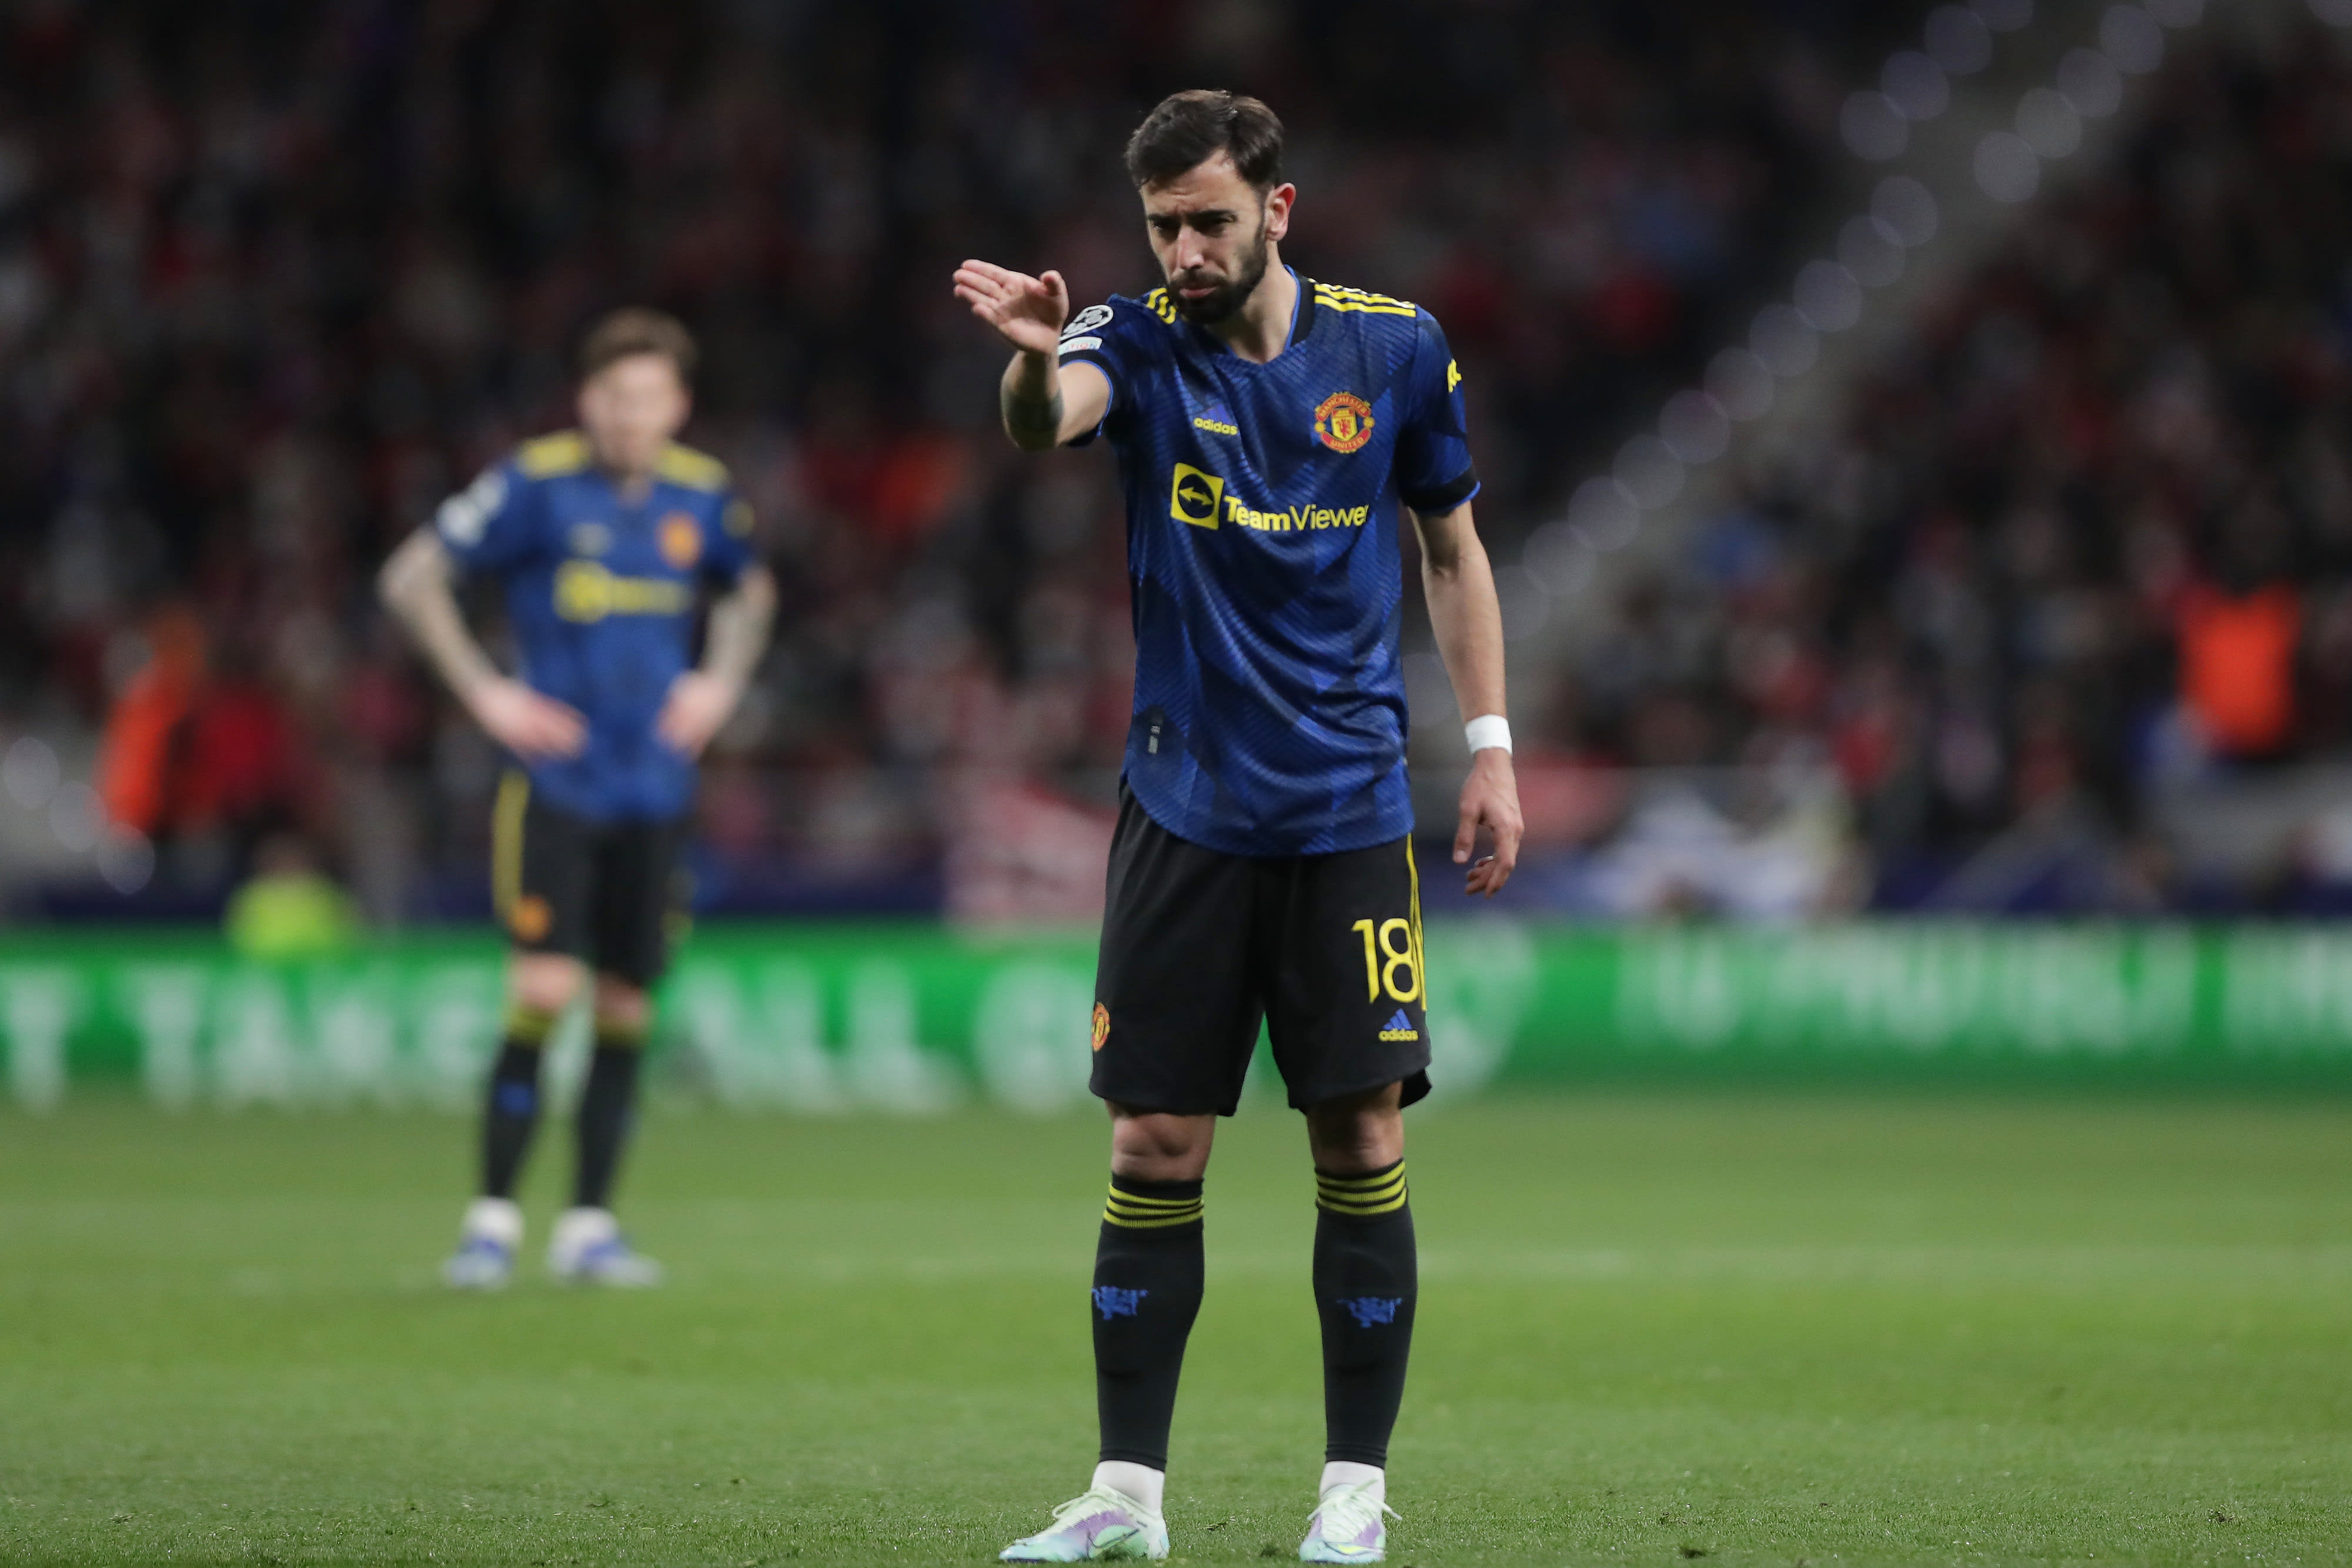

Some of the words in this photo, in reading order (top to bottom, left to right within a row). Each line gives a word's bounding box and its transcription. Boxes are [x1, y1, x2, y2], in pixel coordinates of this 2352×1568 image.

[1194, 417, 1238, 435] adidas
[1329, 436, 1364, 450] UNITED
[1224, 495, 1369, 531] TeamViewer
[1351, 918, 1419, 1004] 18
[1378, 1028, 1419, 1041] adidas
